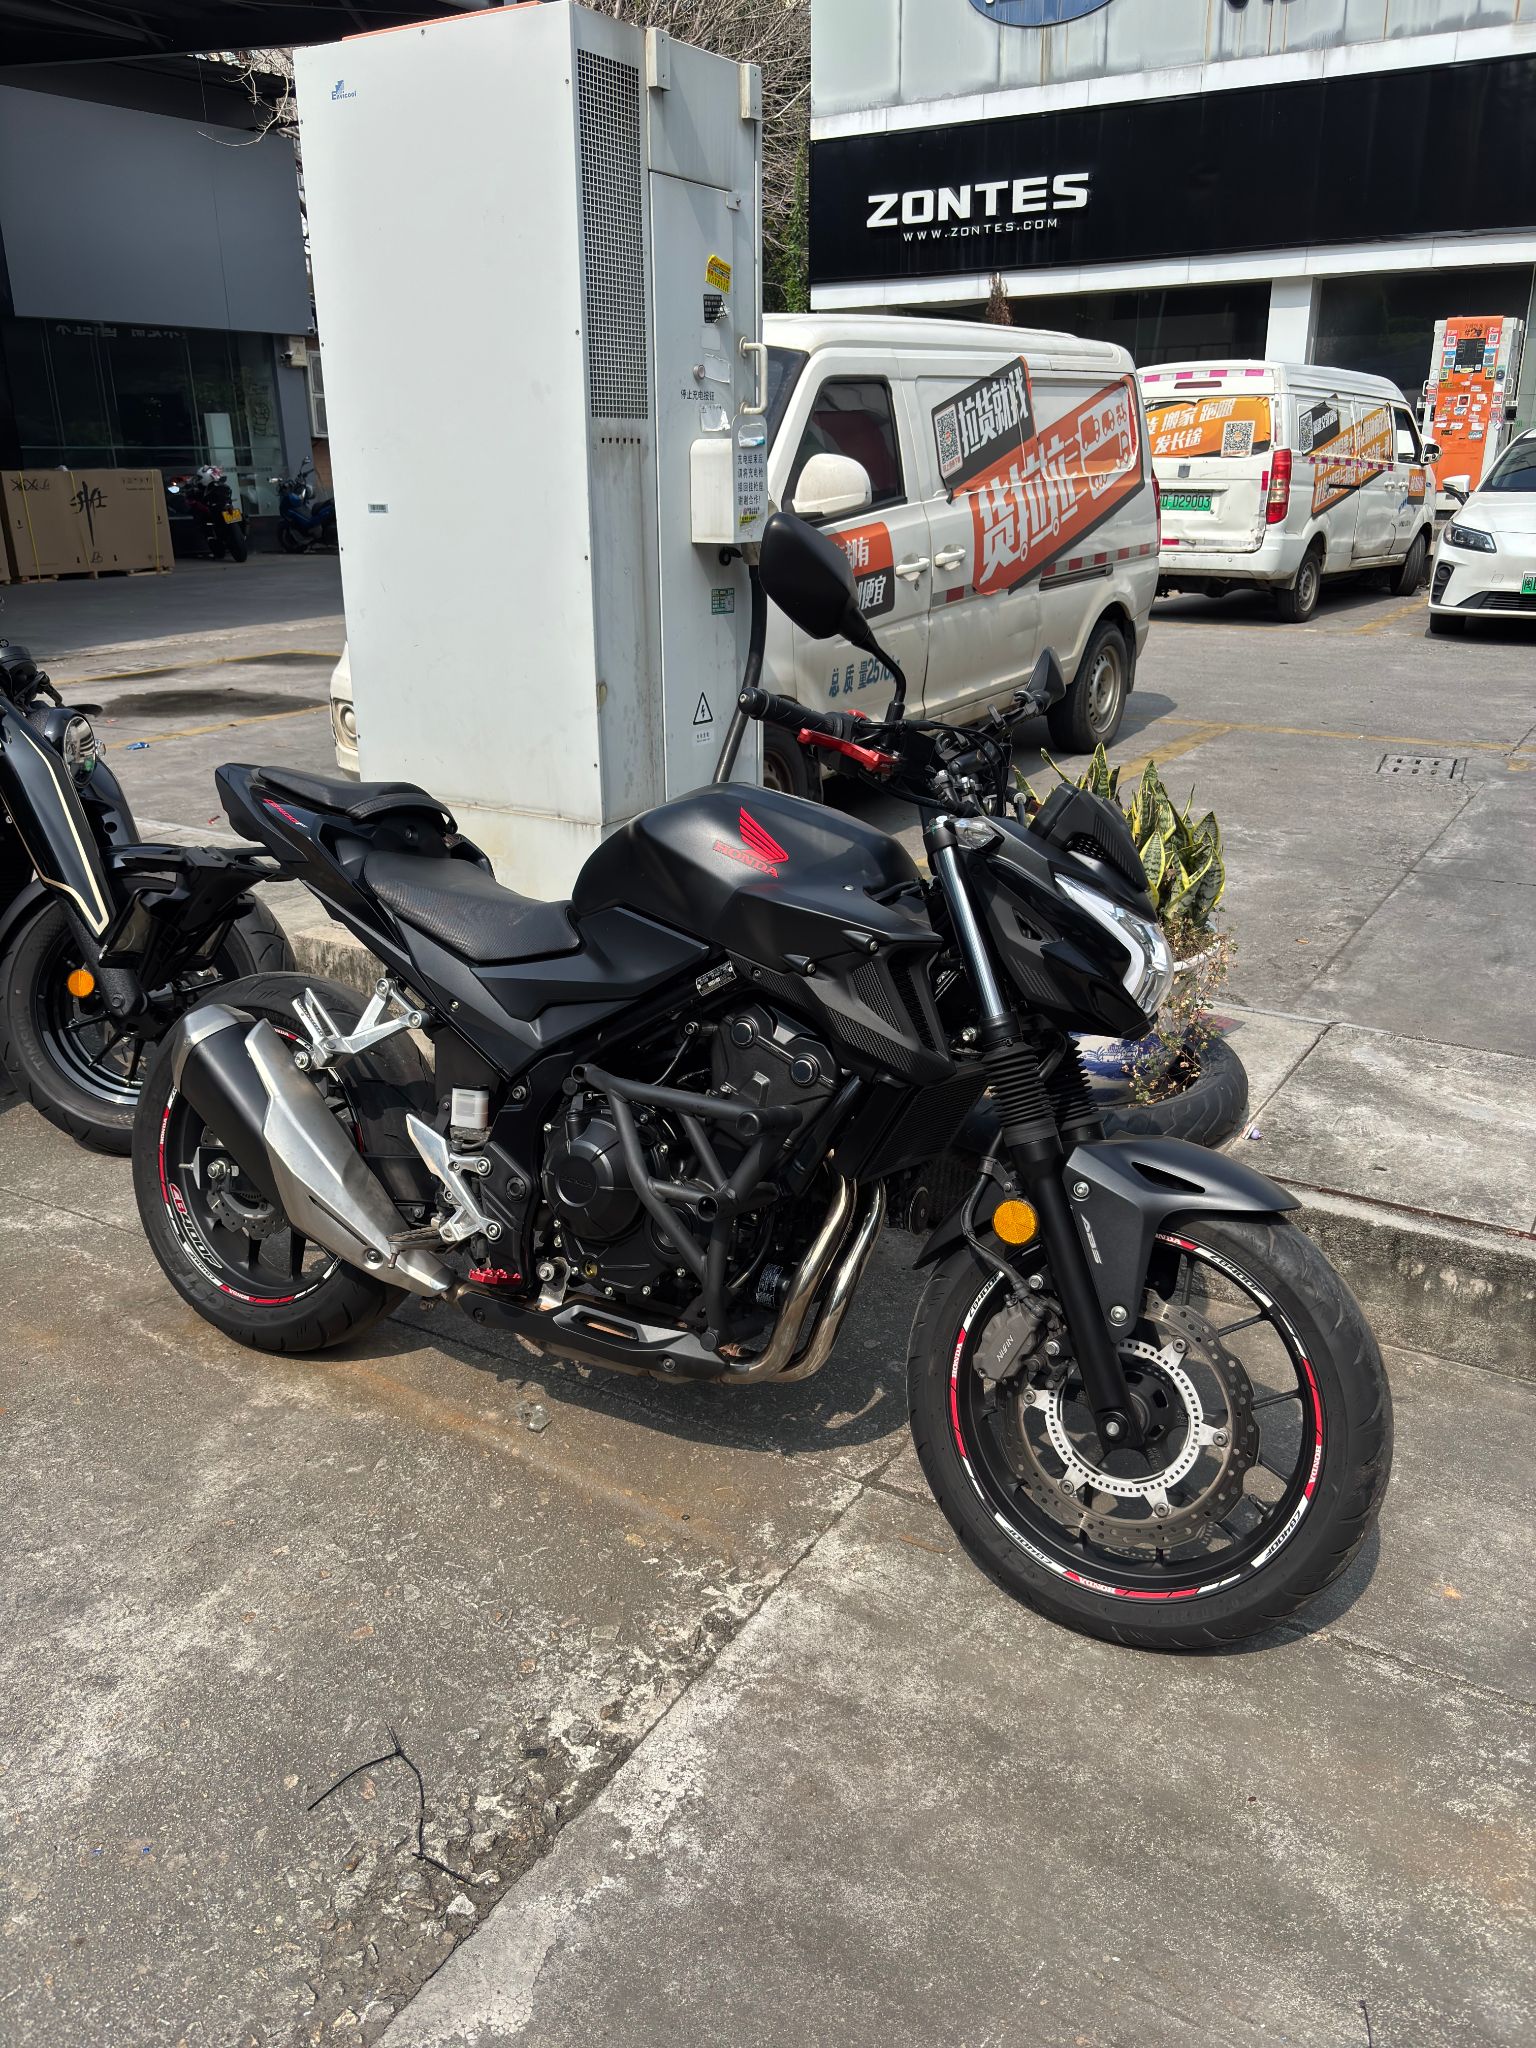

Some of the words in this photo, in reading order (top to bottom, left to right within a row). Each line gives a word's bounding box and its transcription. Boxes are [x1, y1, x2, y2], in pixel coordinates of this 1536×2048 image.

[867, 172, 1090, 229] ZONTES
[902, 217, 1059, 243] WWW.ZONTES.COM
[957, 366, 1029, 459] 拉货就找
[1160, 407, 1199, 433] 搬家
[1153, 427, 1203, 454] 发长途
[977, 430, 1088, 585] 货拉拉
[712, 840, 779, 879] HONDA
[1080, 1213, 1103, 1265] ABS
[951, 1342, 964, 1378] HONDA
[1309, 1444, 1322, 1485] HONDA
[1077, 1575, 1116, 1594] HONDA
